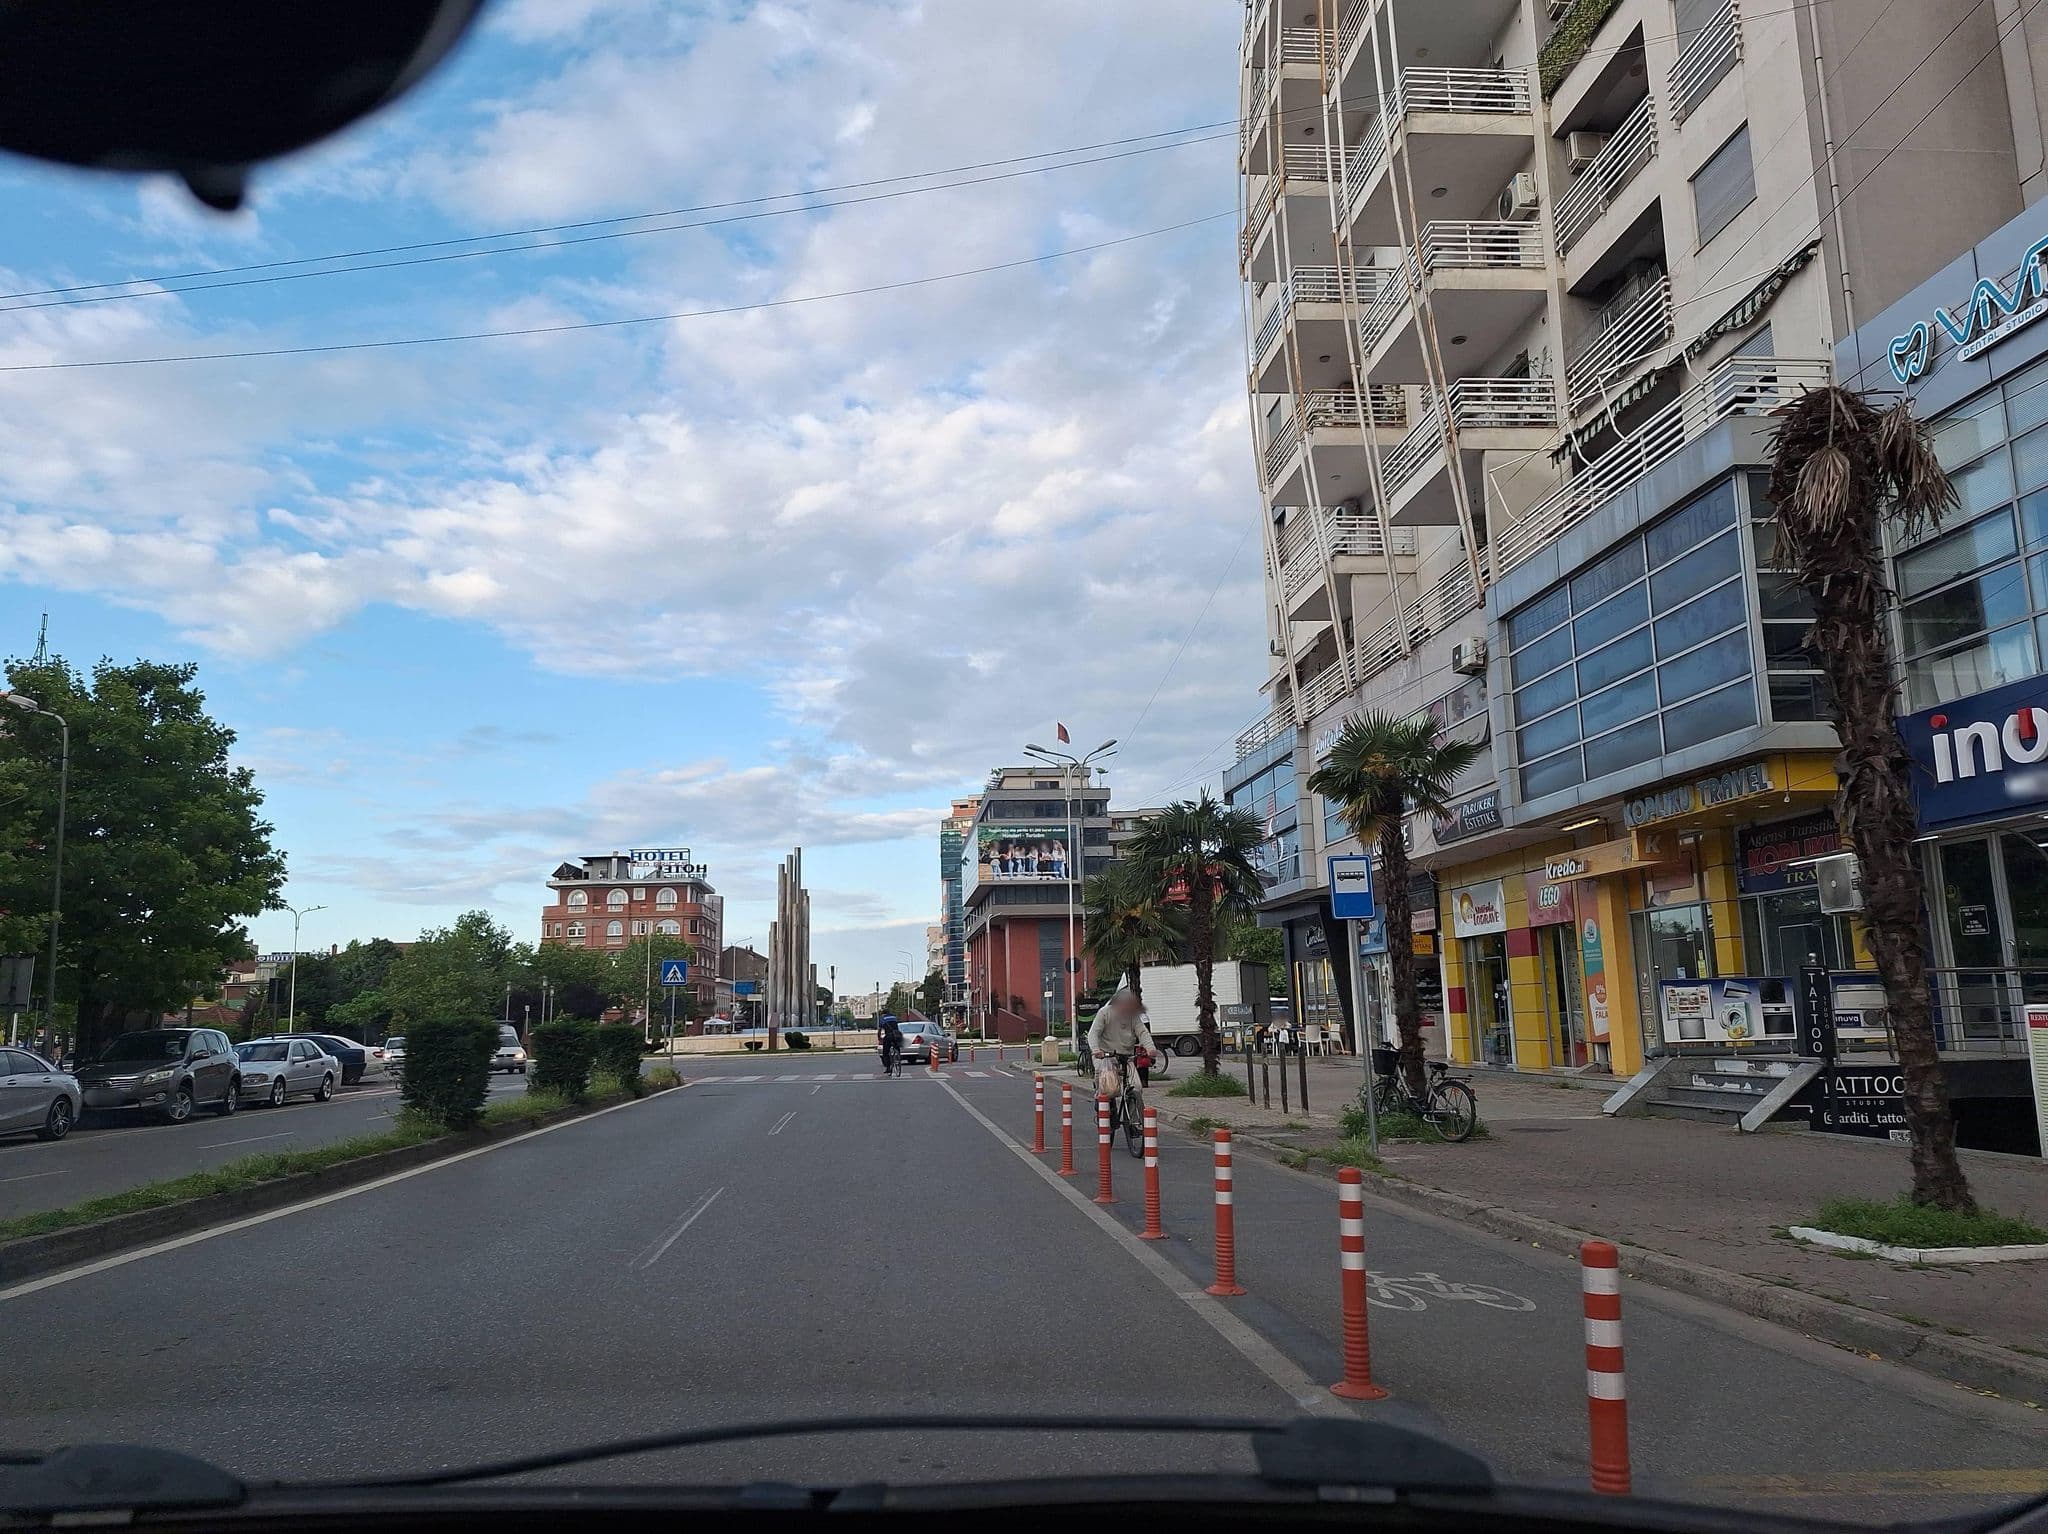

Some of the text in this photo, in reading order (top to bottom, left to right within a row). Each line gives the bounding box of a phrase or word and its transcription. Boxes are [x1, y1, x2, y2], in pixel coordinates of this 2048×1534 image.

[1963, 303, 2044, 358] DENTAL STUDIO
[1462, 795, 1495, 816] PARUKERI
[1623, 762, 1775, 828] KOPLIKU TRAVEL
[631, 852, 688, 861] HOTEL
[1545, 859, 1585, 880] Kredo.al
[1784, 868, 1818, 884] TRA
[1538, 885, 1560, 909] LEGO
[1807, 972, 1824, 1054] TATTOO
